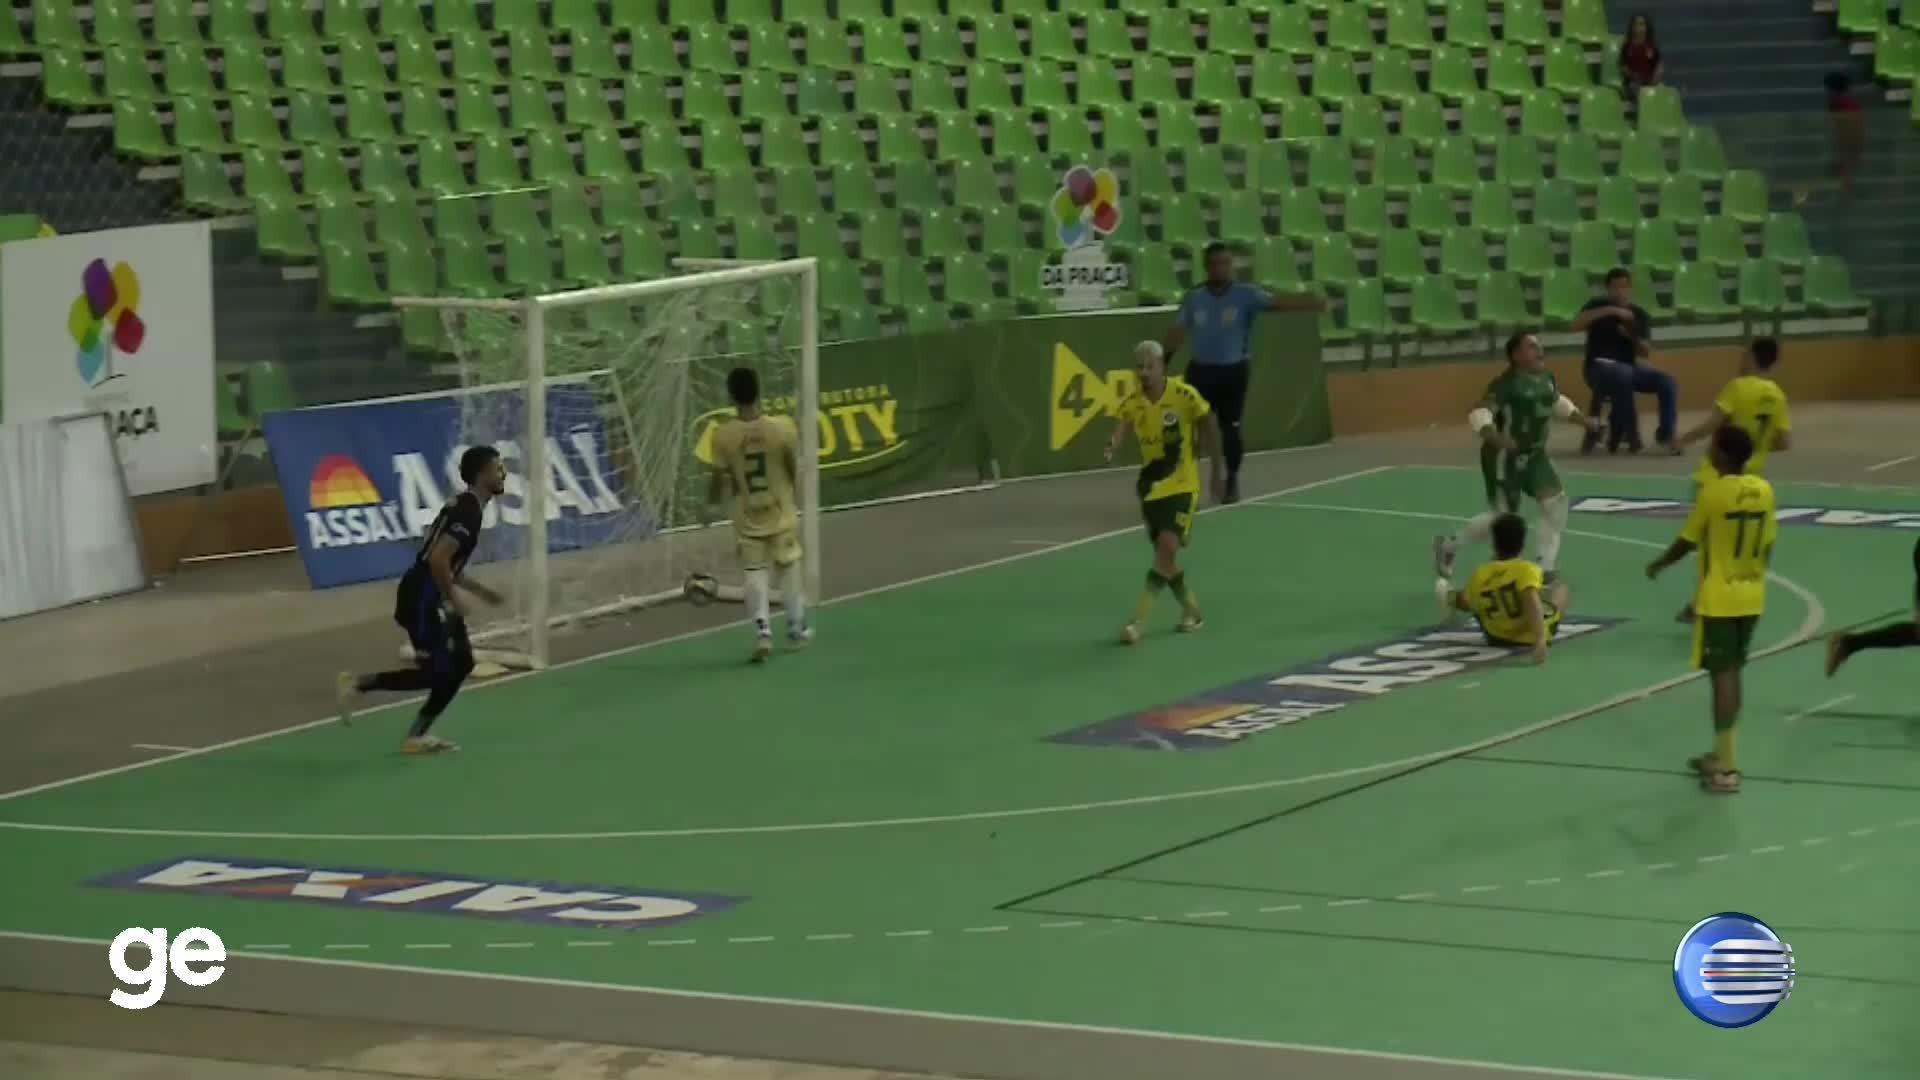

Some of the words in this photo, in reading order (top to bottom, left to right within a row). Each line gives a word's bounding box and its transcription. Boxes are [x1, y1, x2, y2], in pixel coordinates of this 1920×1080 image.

[1058, 373, 1095, 417] 4
[745, 452, 768, 493] 2
[1724, 510, 1767, 558] 77
[136, 860, 698, 921] CAIXA
